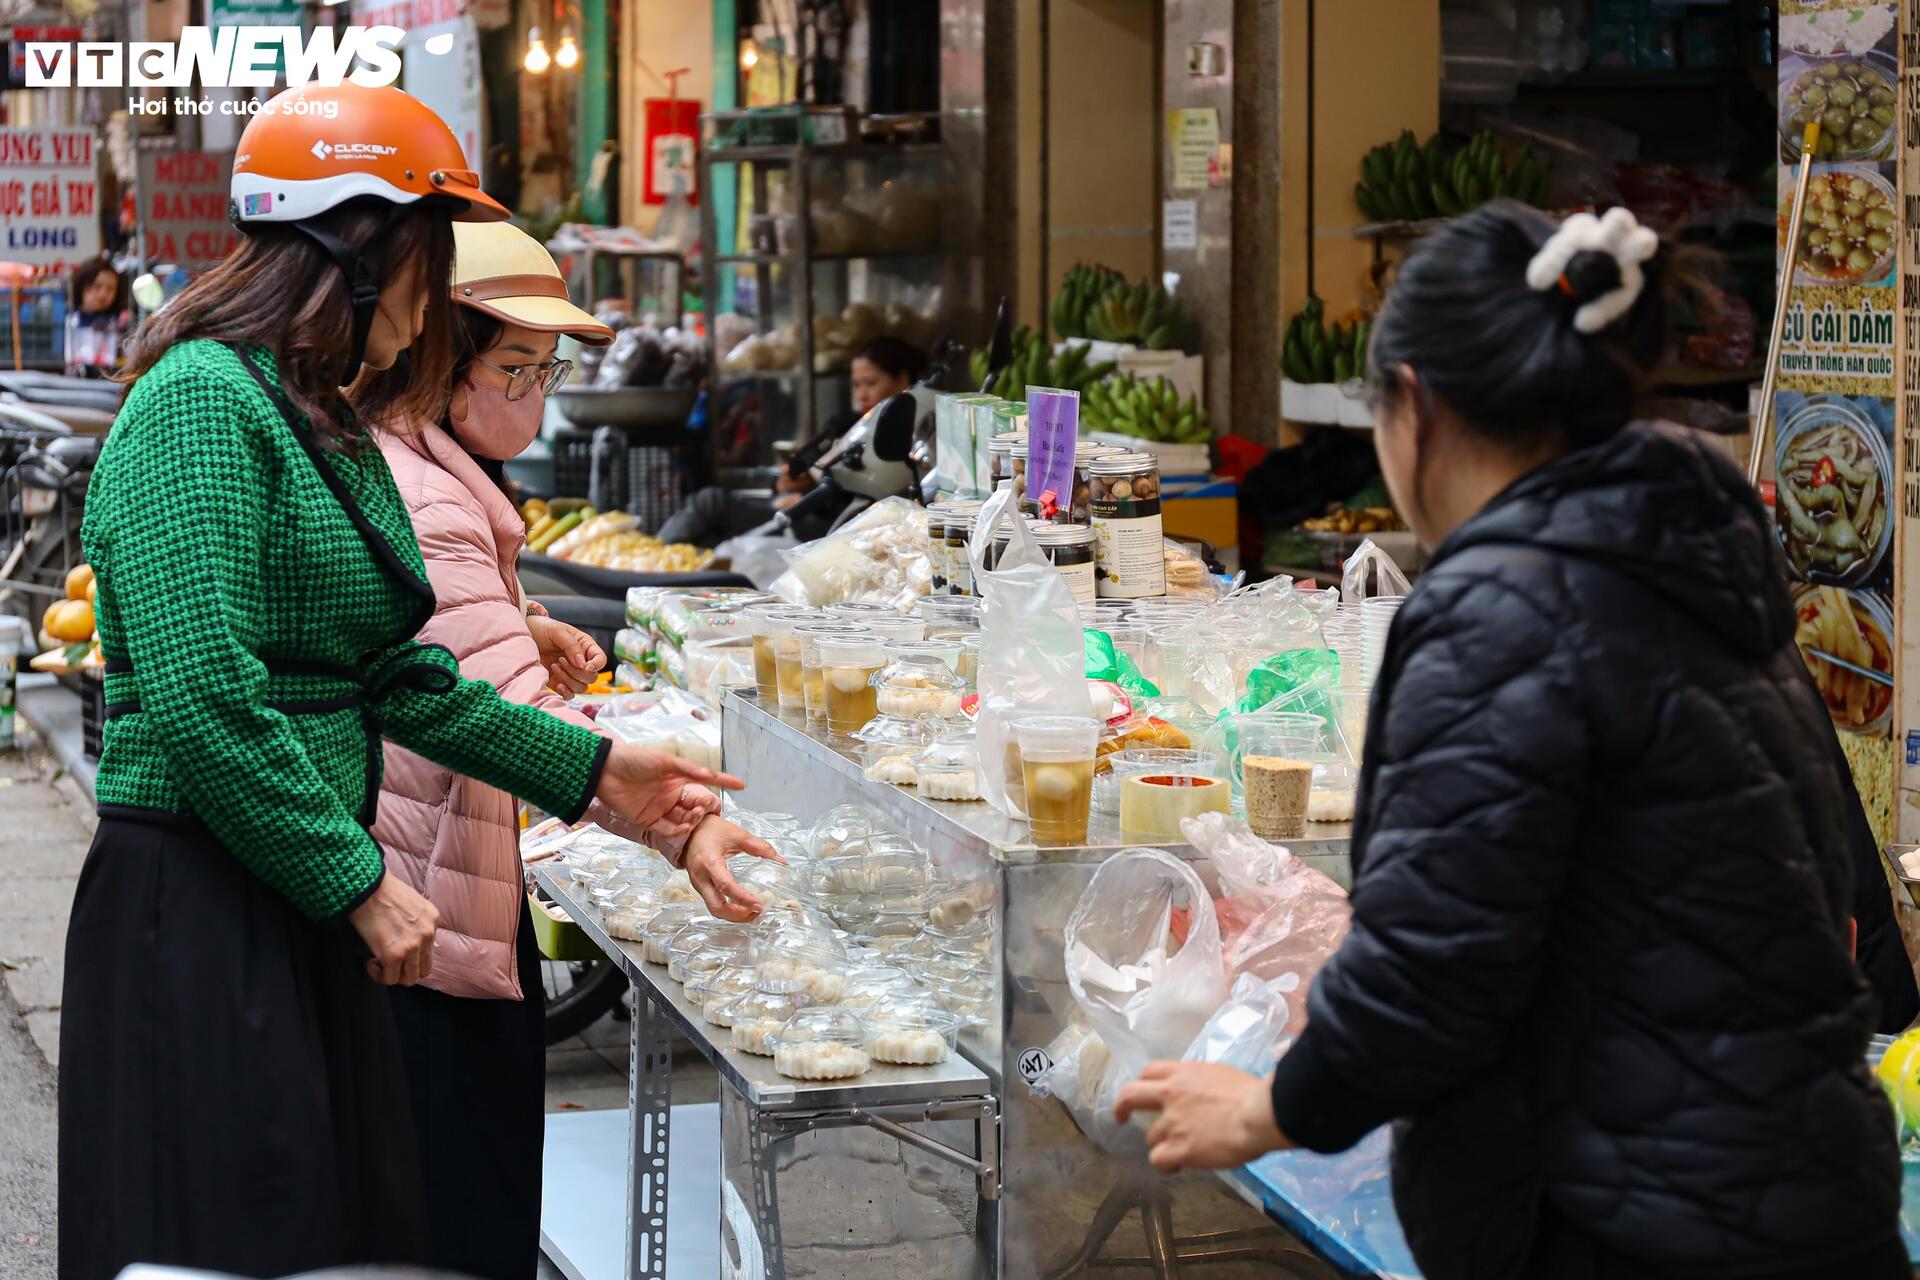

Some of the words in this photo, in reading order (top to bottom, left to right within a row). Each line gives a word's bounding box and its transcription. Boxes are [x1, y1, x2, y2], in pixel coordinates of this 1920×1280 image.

[334, 144, 397, 155] CLICKBUY
[8, 226, 77, 249] LONG
[1812, 303, 1841, 342] CẢI
[1849, 301, 1892, 344] DẦM
[1847, 353, 1864, 372] HÀN
